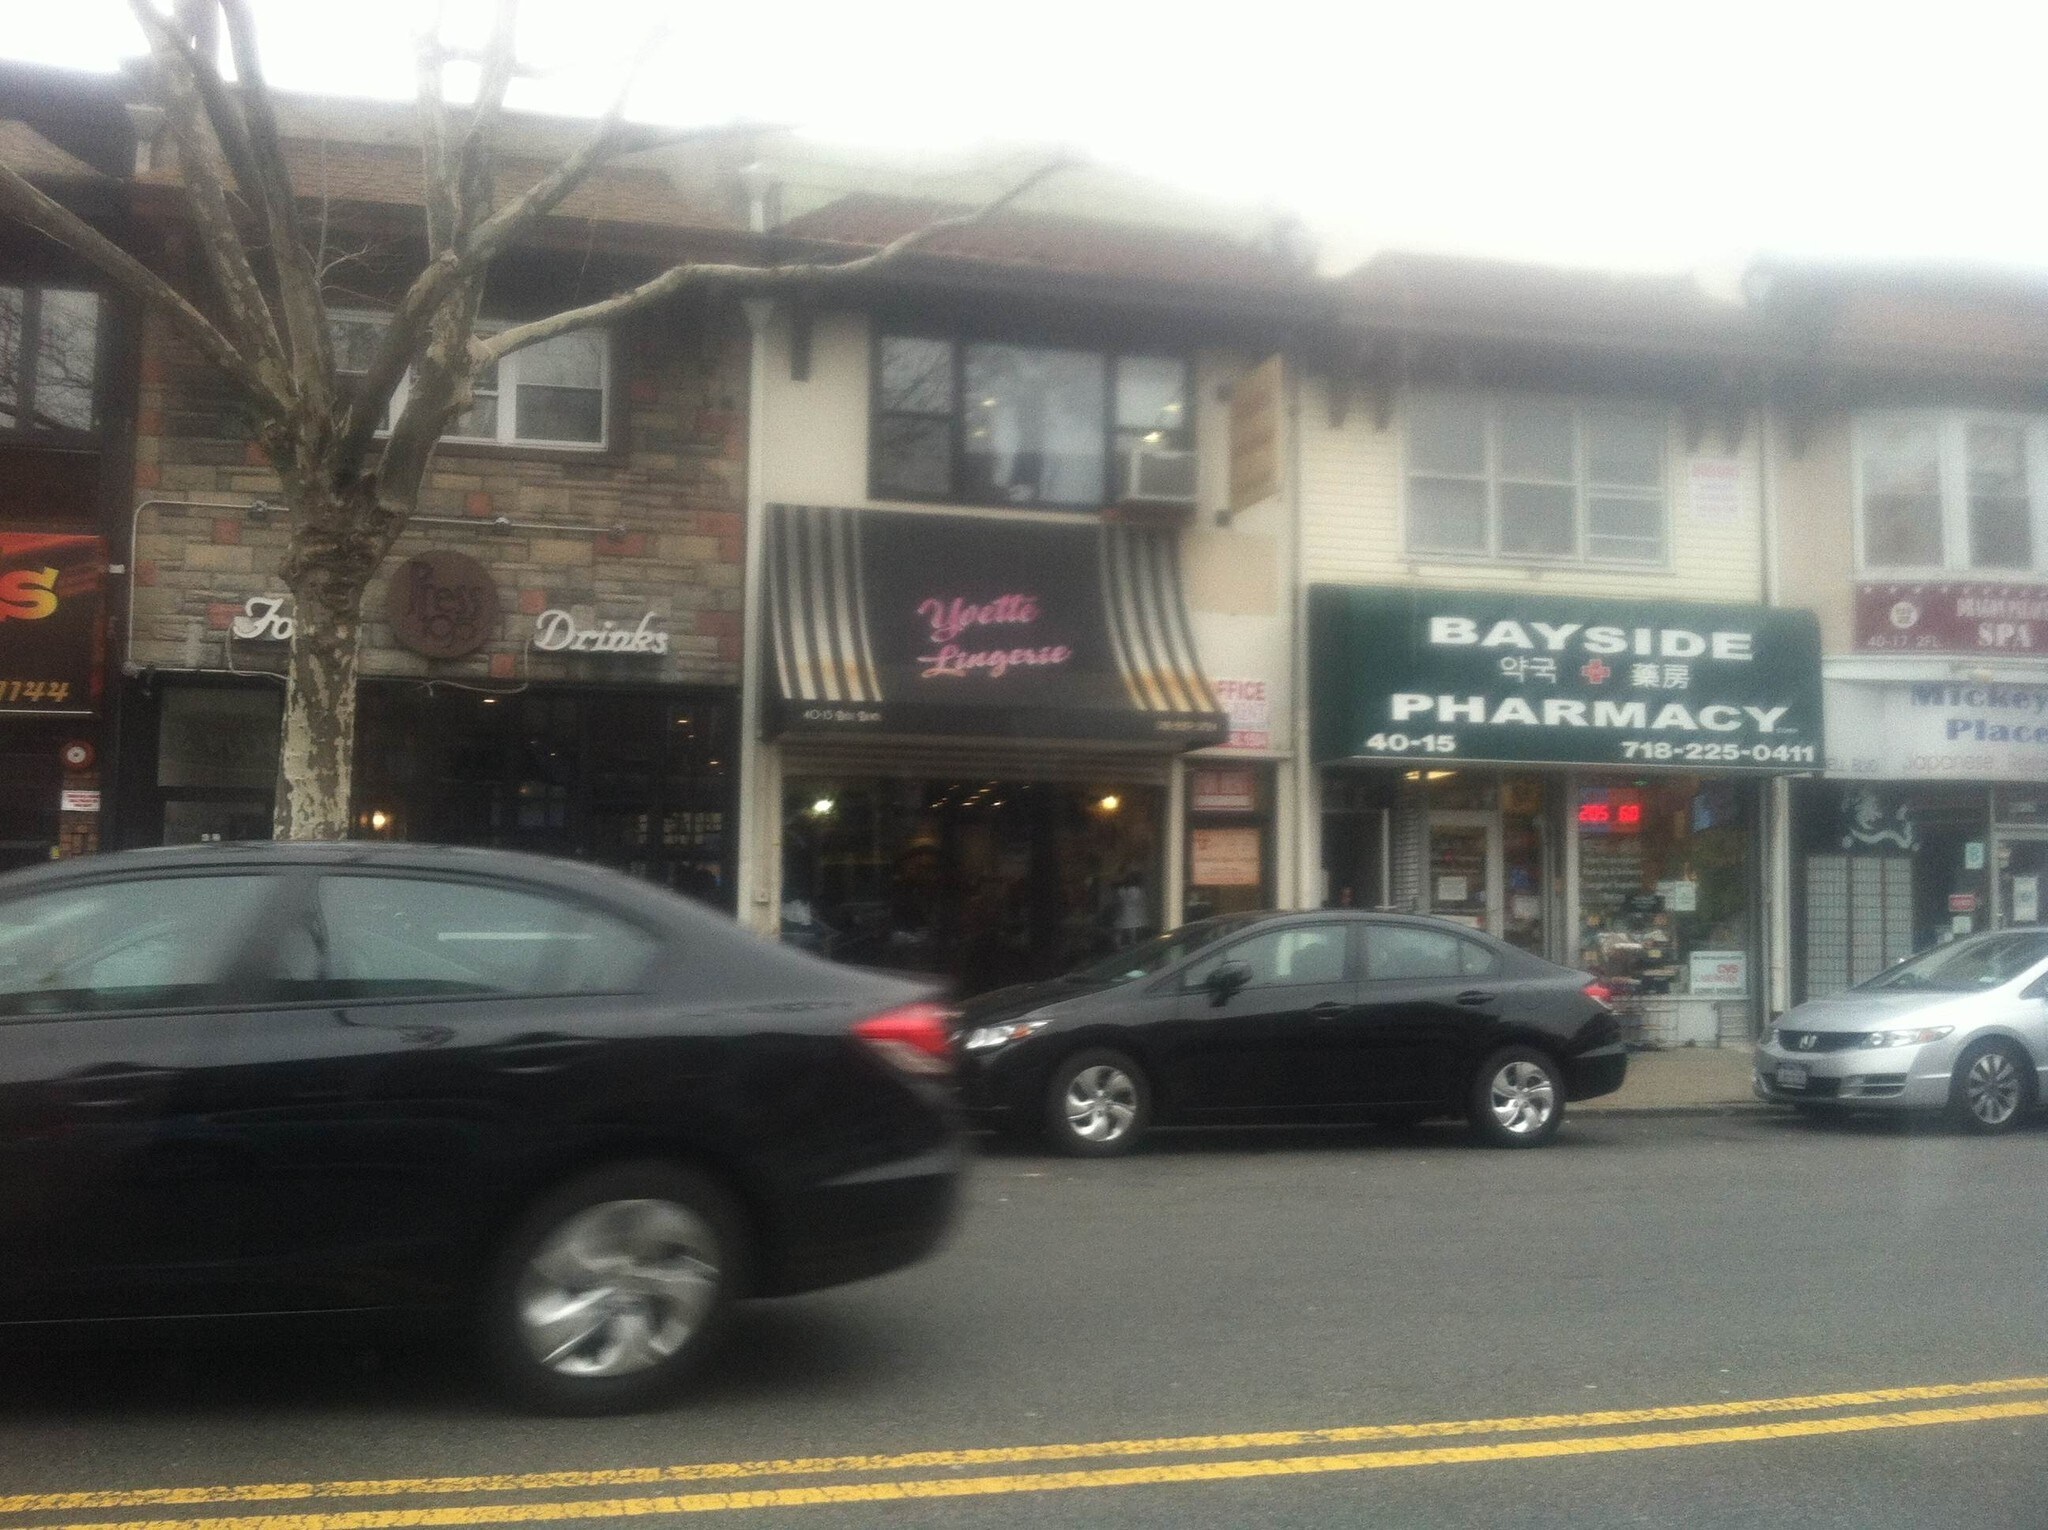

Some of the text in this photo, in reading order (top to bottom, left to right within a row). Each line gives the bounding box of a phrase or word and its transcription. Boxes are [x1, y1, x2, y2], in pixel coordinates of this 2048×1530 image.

[232, 596, 294, 640] Fo
[534, 609, 669, 655] Drinks
[917, 594, 1041, 643] Yvette
[1977, 623, 2032, 648] SPA
[1429, 615, 1754, 661] BAYSIDE
[917, 645, 1072, 678] Lingerie
[1500, 655, 1557, 685] 약국
[1390, 693, 1789, 734] PHARMACY
[1365, 733, 1457, 754] 40-15
[1621, 741, 1815, 763] 718-225-0411
